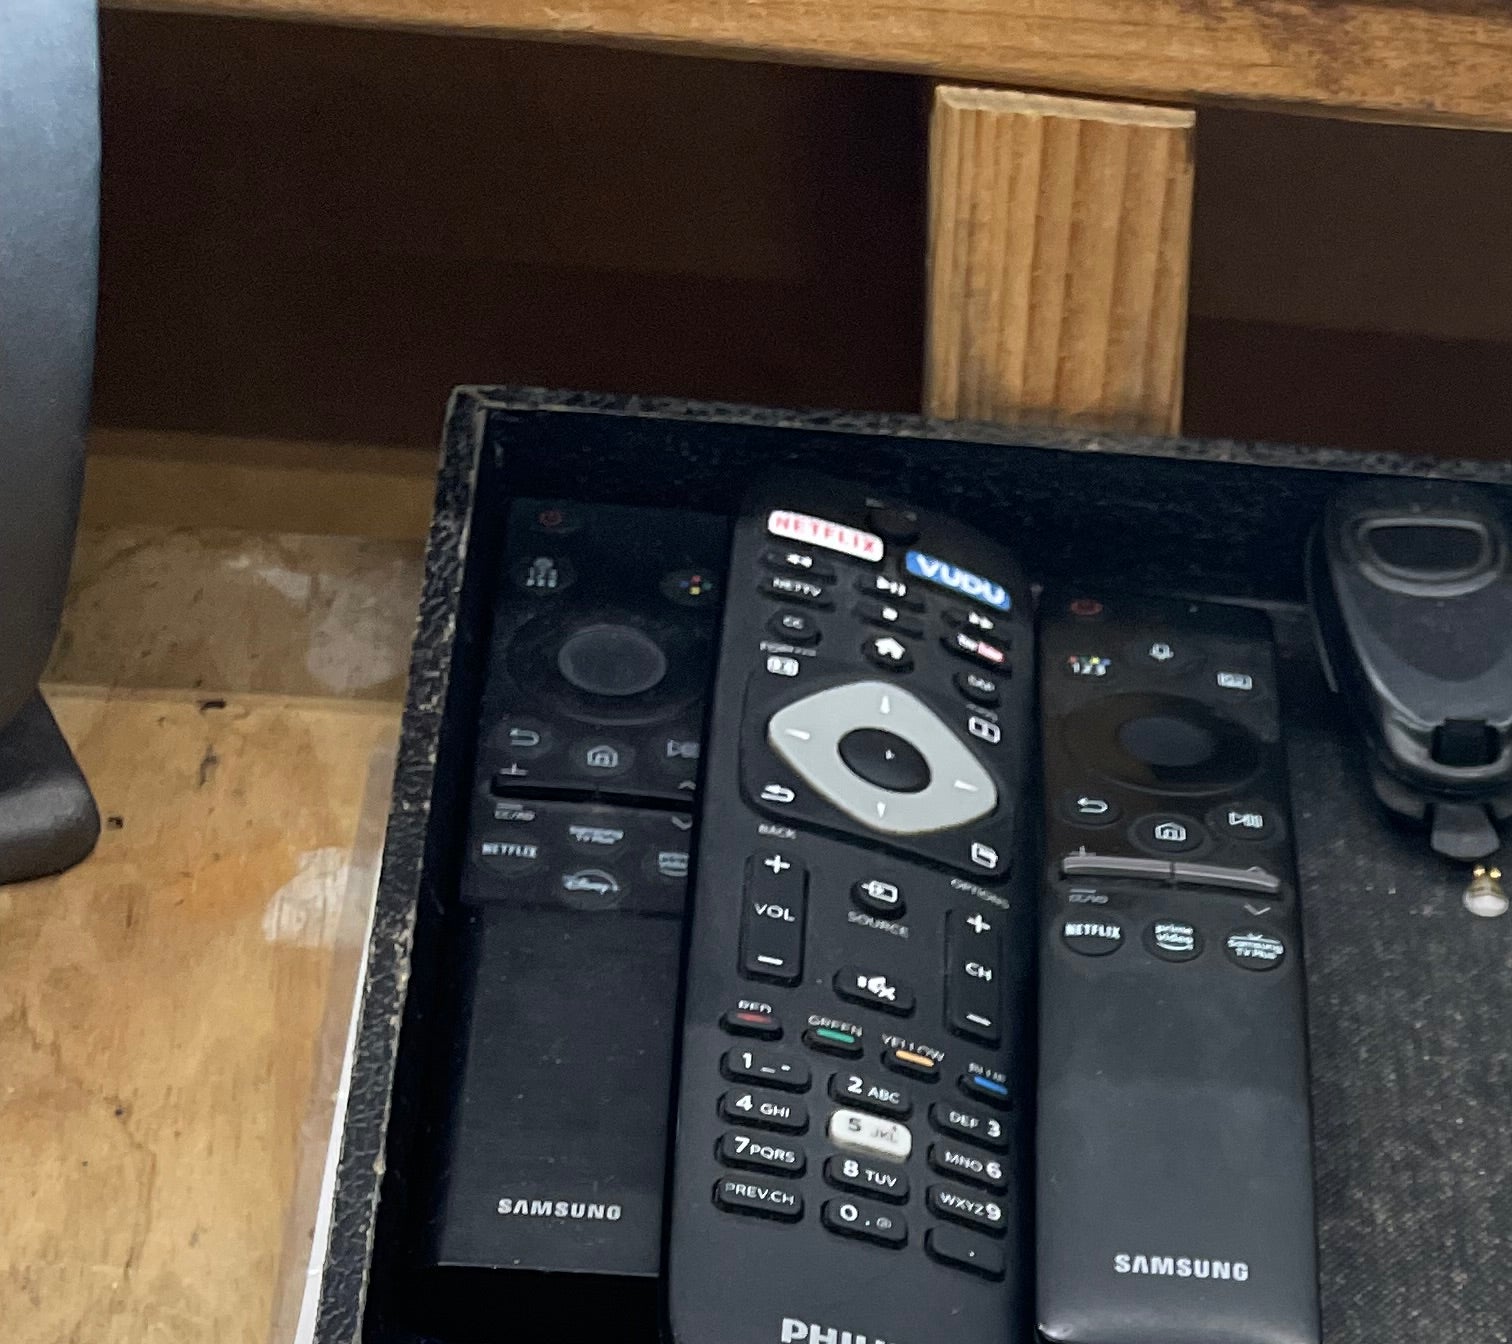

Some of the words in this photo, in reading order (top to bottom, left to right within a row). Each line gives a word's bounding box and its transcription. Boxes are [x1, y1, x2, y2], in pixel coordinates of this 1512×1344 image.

[775, 515, 876, 553] NETFLIX
[916, 553, 1006, 606] VUDU
[753, 902, 796, 923] VOL
[847, 910, 910, 939] SOURCE
[1064, 922, 1122, 940] NETFLIX
[964, 961, 993, 982] CH
[741, 1052, 754, 1069] 1
[846, 1076, 863, 1094] 2
[867, 1085, 900, 1105] ABC
[735, 1094, 754, 1112] 4
[759, 1102, 791, 1119] GHI
[847, 1118, 862, 1133] 5
[949, 1110, 979, 1129] DEF
[987, 1119, 1002, 1138] 3
[734, 1136, 751, 1154] 7
[750, 1143, 796, 1163] PQRS
[842, 1159, 860, 1178] 8
[864, 1168, 898, 1188] TUV
[944, 1151, 983, 1173] MNO
[986, 1162, 1003, 1180] 6
[497, 1197, 623, 1222] SAMSUNG
[939, 1191, 984, 1215] WXYZ
[985, 1202, 1002, 1221] 9
[1113, 1252, 1250, 1282] SAMSUNG
